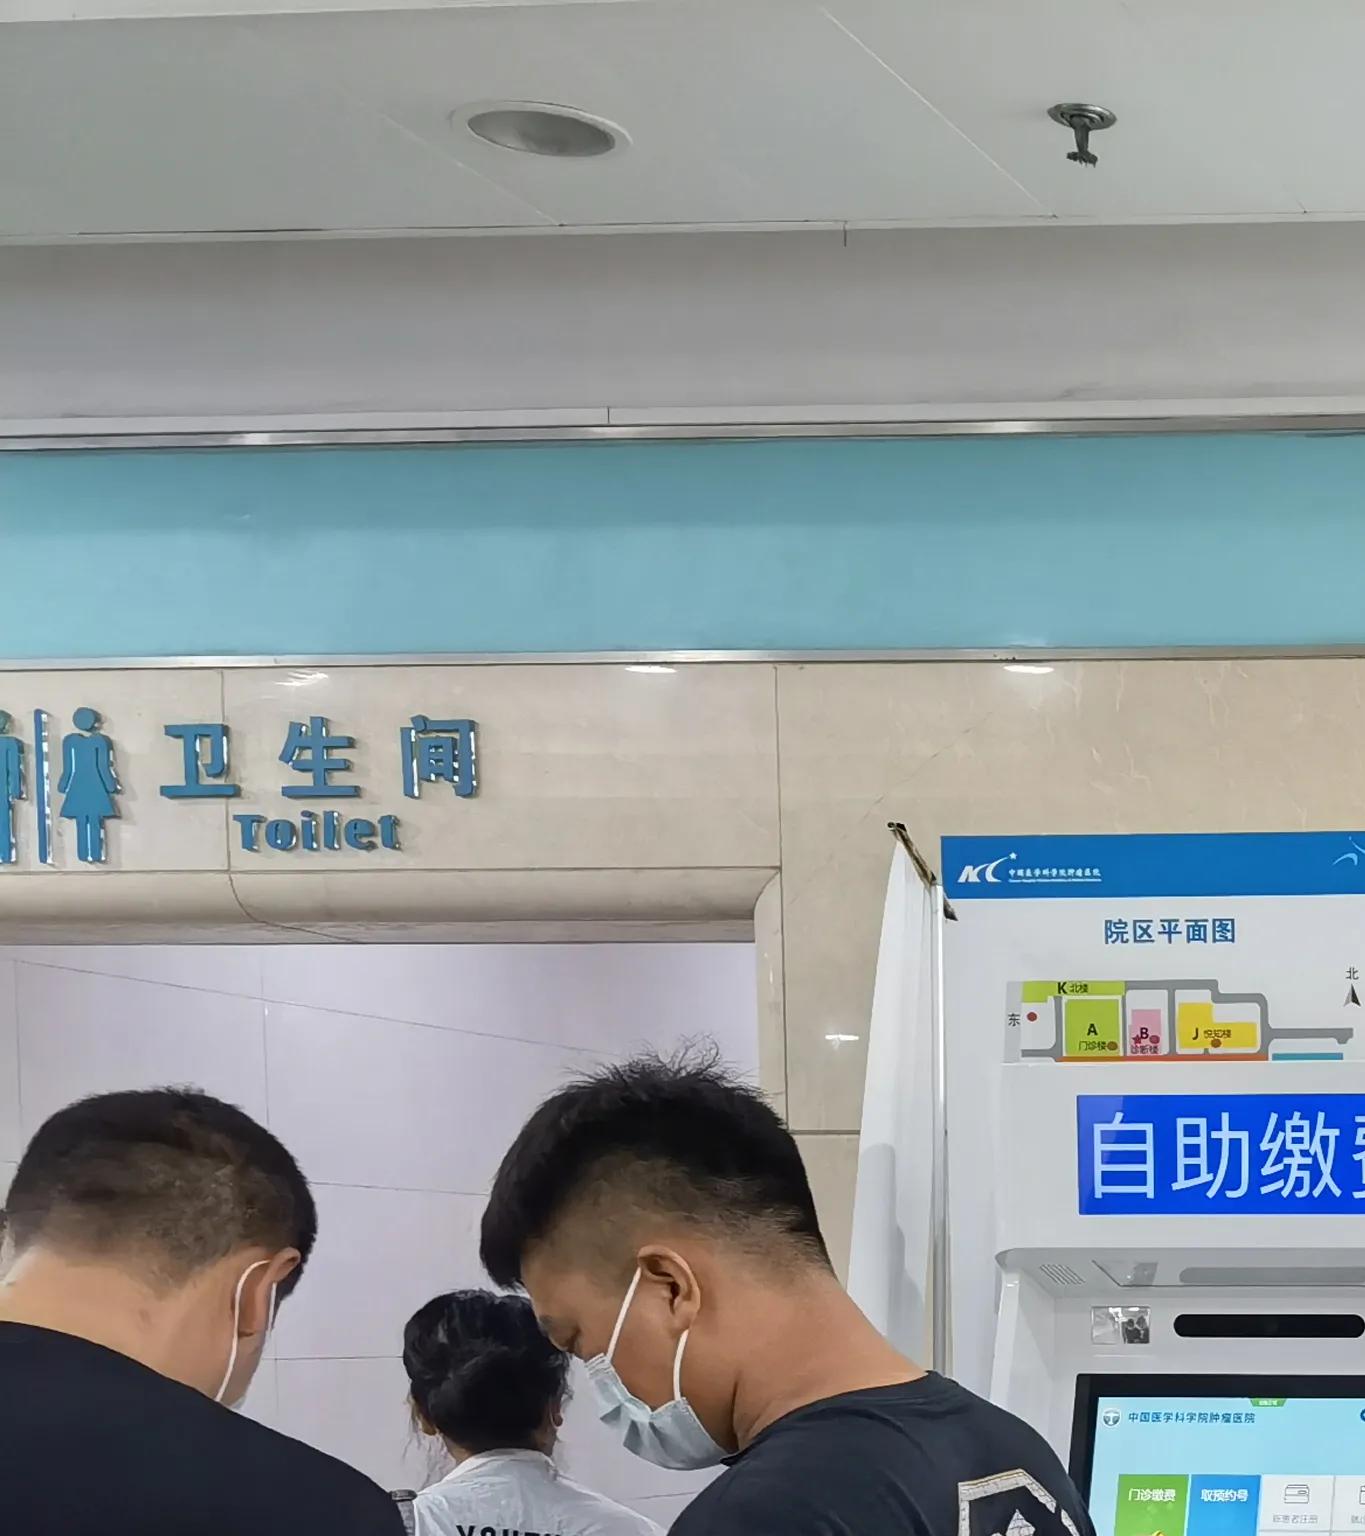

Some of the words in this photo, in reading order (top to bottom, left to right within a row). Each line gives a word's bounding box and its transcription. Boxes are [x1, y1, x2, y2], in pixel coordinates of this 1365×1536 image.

[160, 714, 481, 800] 卫生间
[233, 810, 404, 853] Toilet
[1103, 918, 1237, 945] 院区平面图
[1346, 967, 1360, 981] 北
[1057, 982, 1068, 995] K
[1008, 1013, 1021, 1026] 东
[1087, 1023, 1098, 1036] A
[1140, 1027, 1149, 1039] B
[1128, 1411, 1256, 1424] 中国医学科学院肿瘤医院
